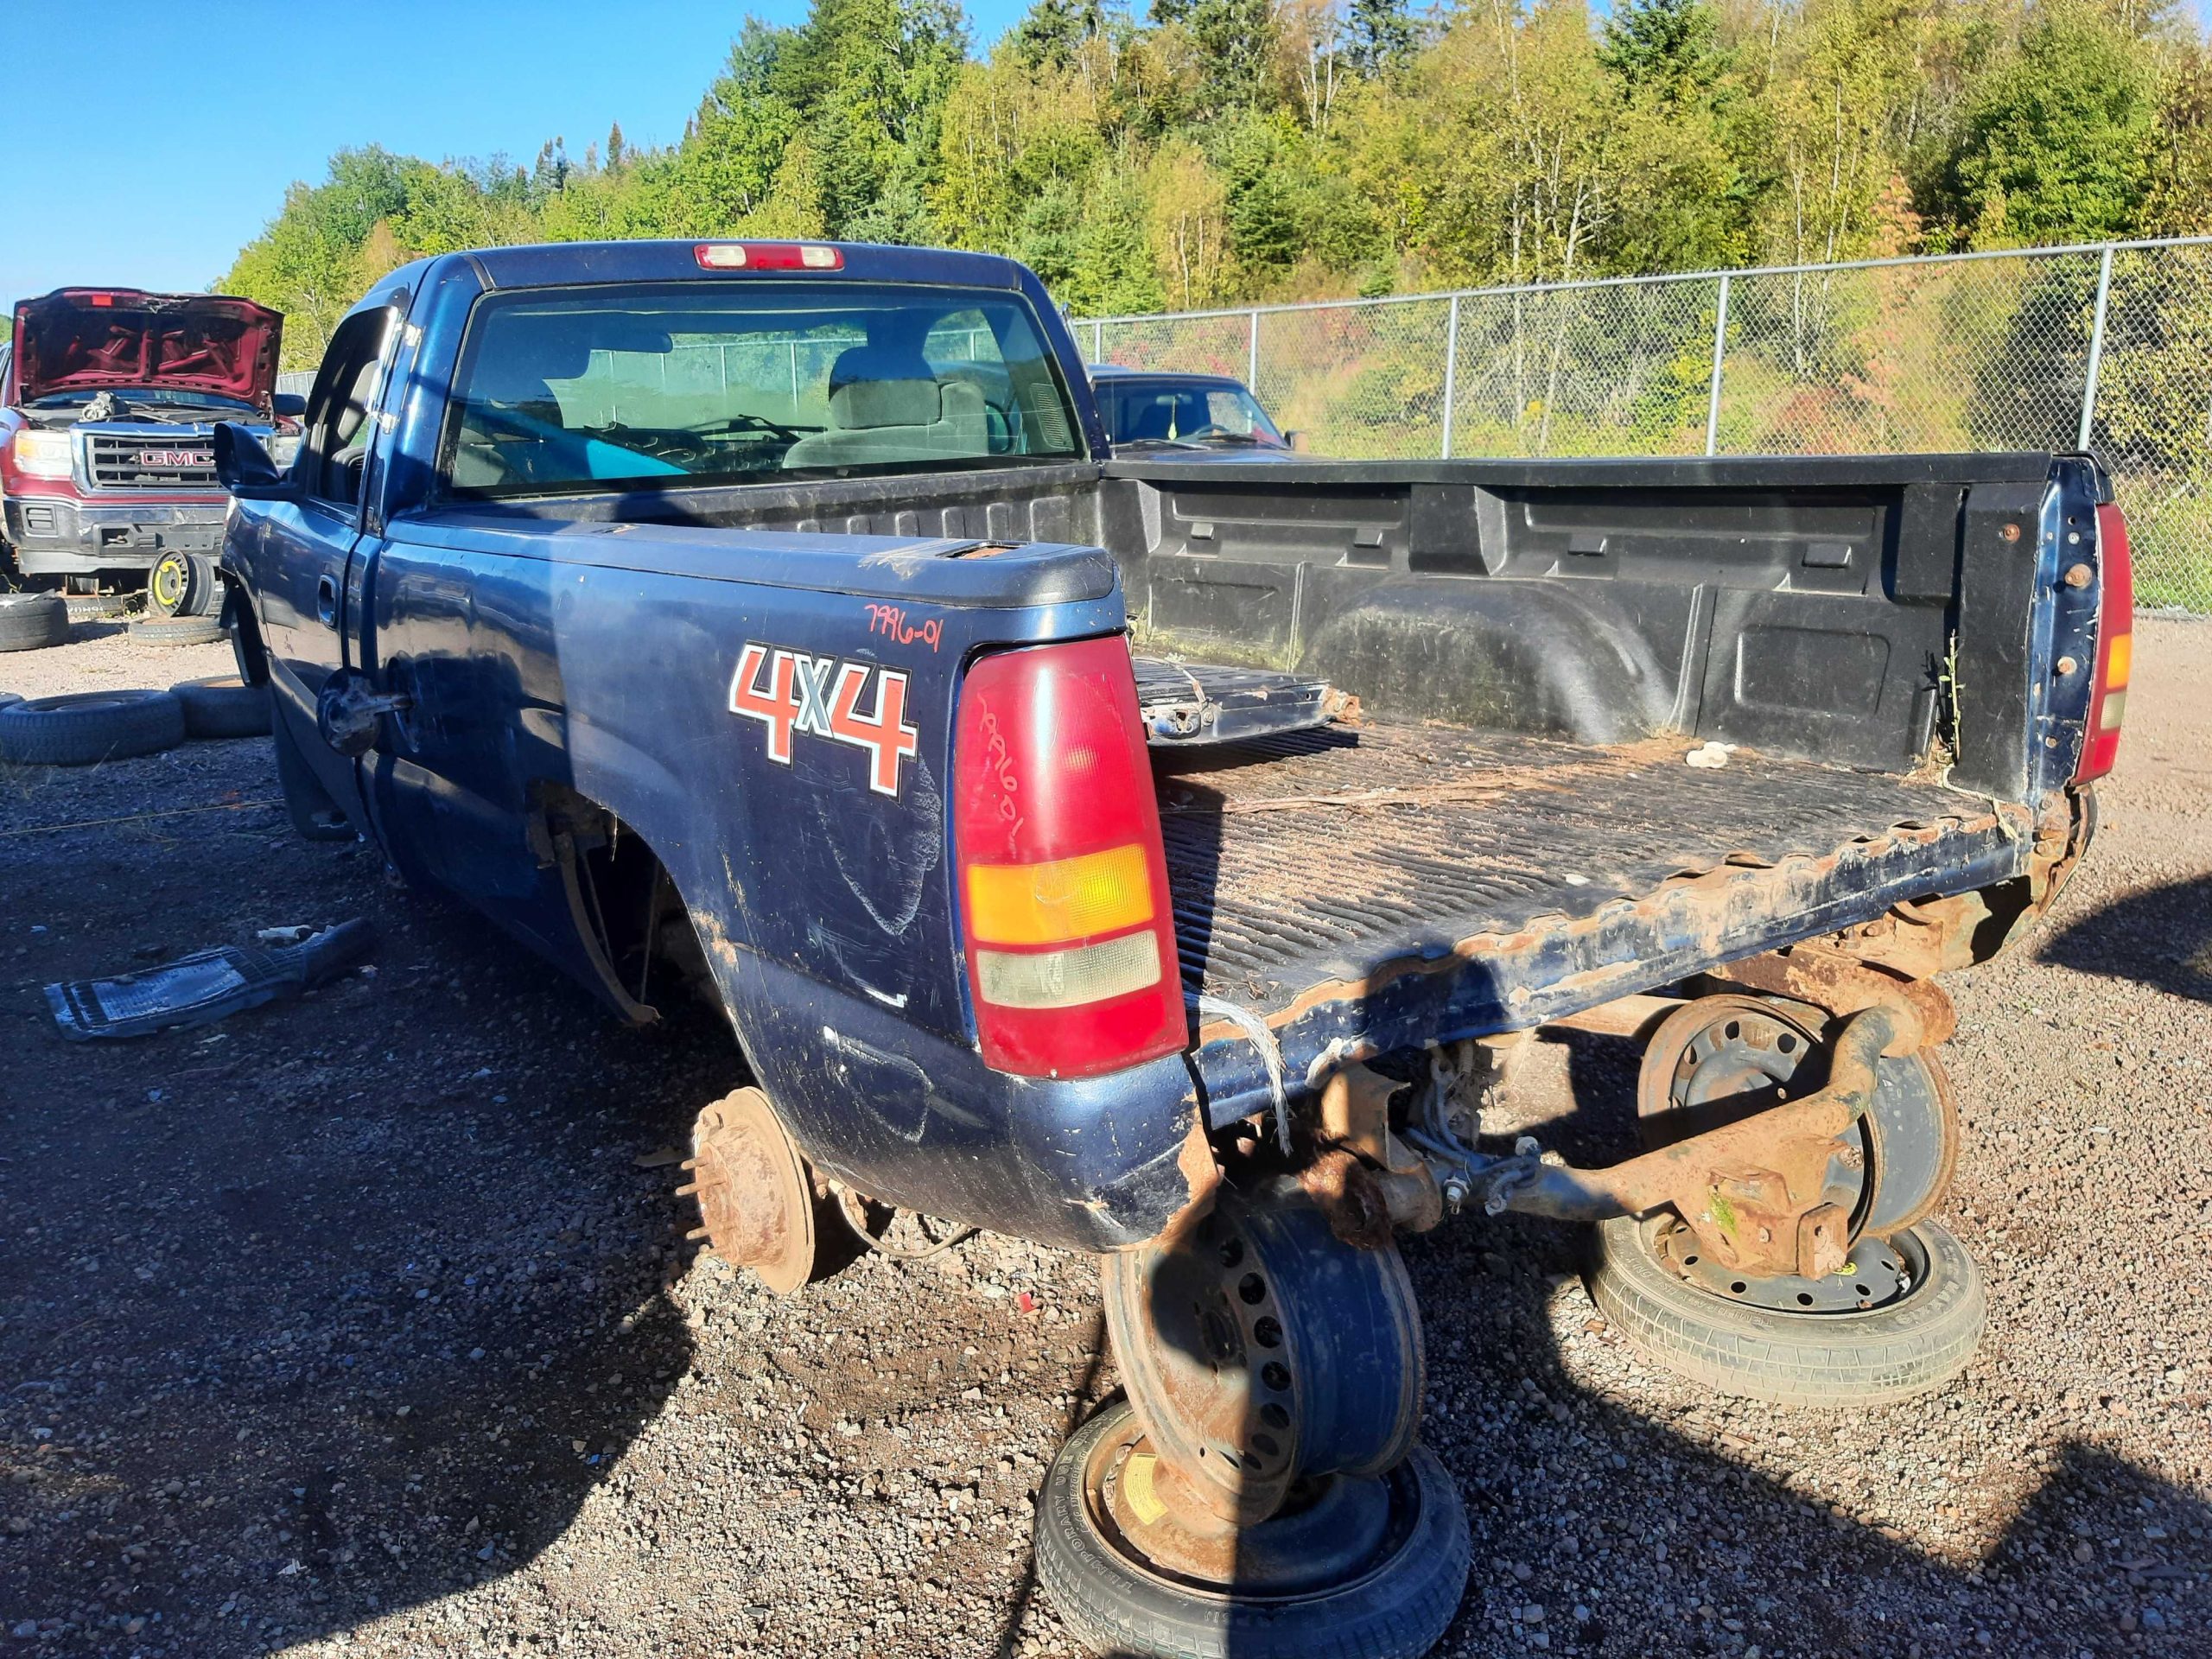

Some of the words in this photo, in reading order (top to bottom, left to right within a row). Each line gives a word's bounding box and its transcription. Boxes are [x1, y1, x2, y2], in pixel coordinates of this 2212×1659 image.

[139, 450, 216, 467] GMC
[1055, 1455, 1075, 1486] USE
[1054, 1495, 1135, 1595] TEMPORARY
